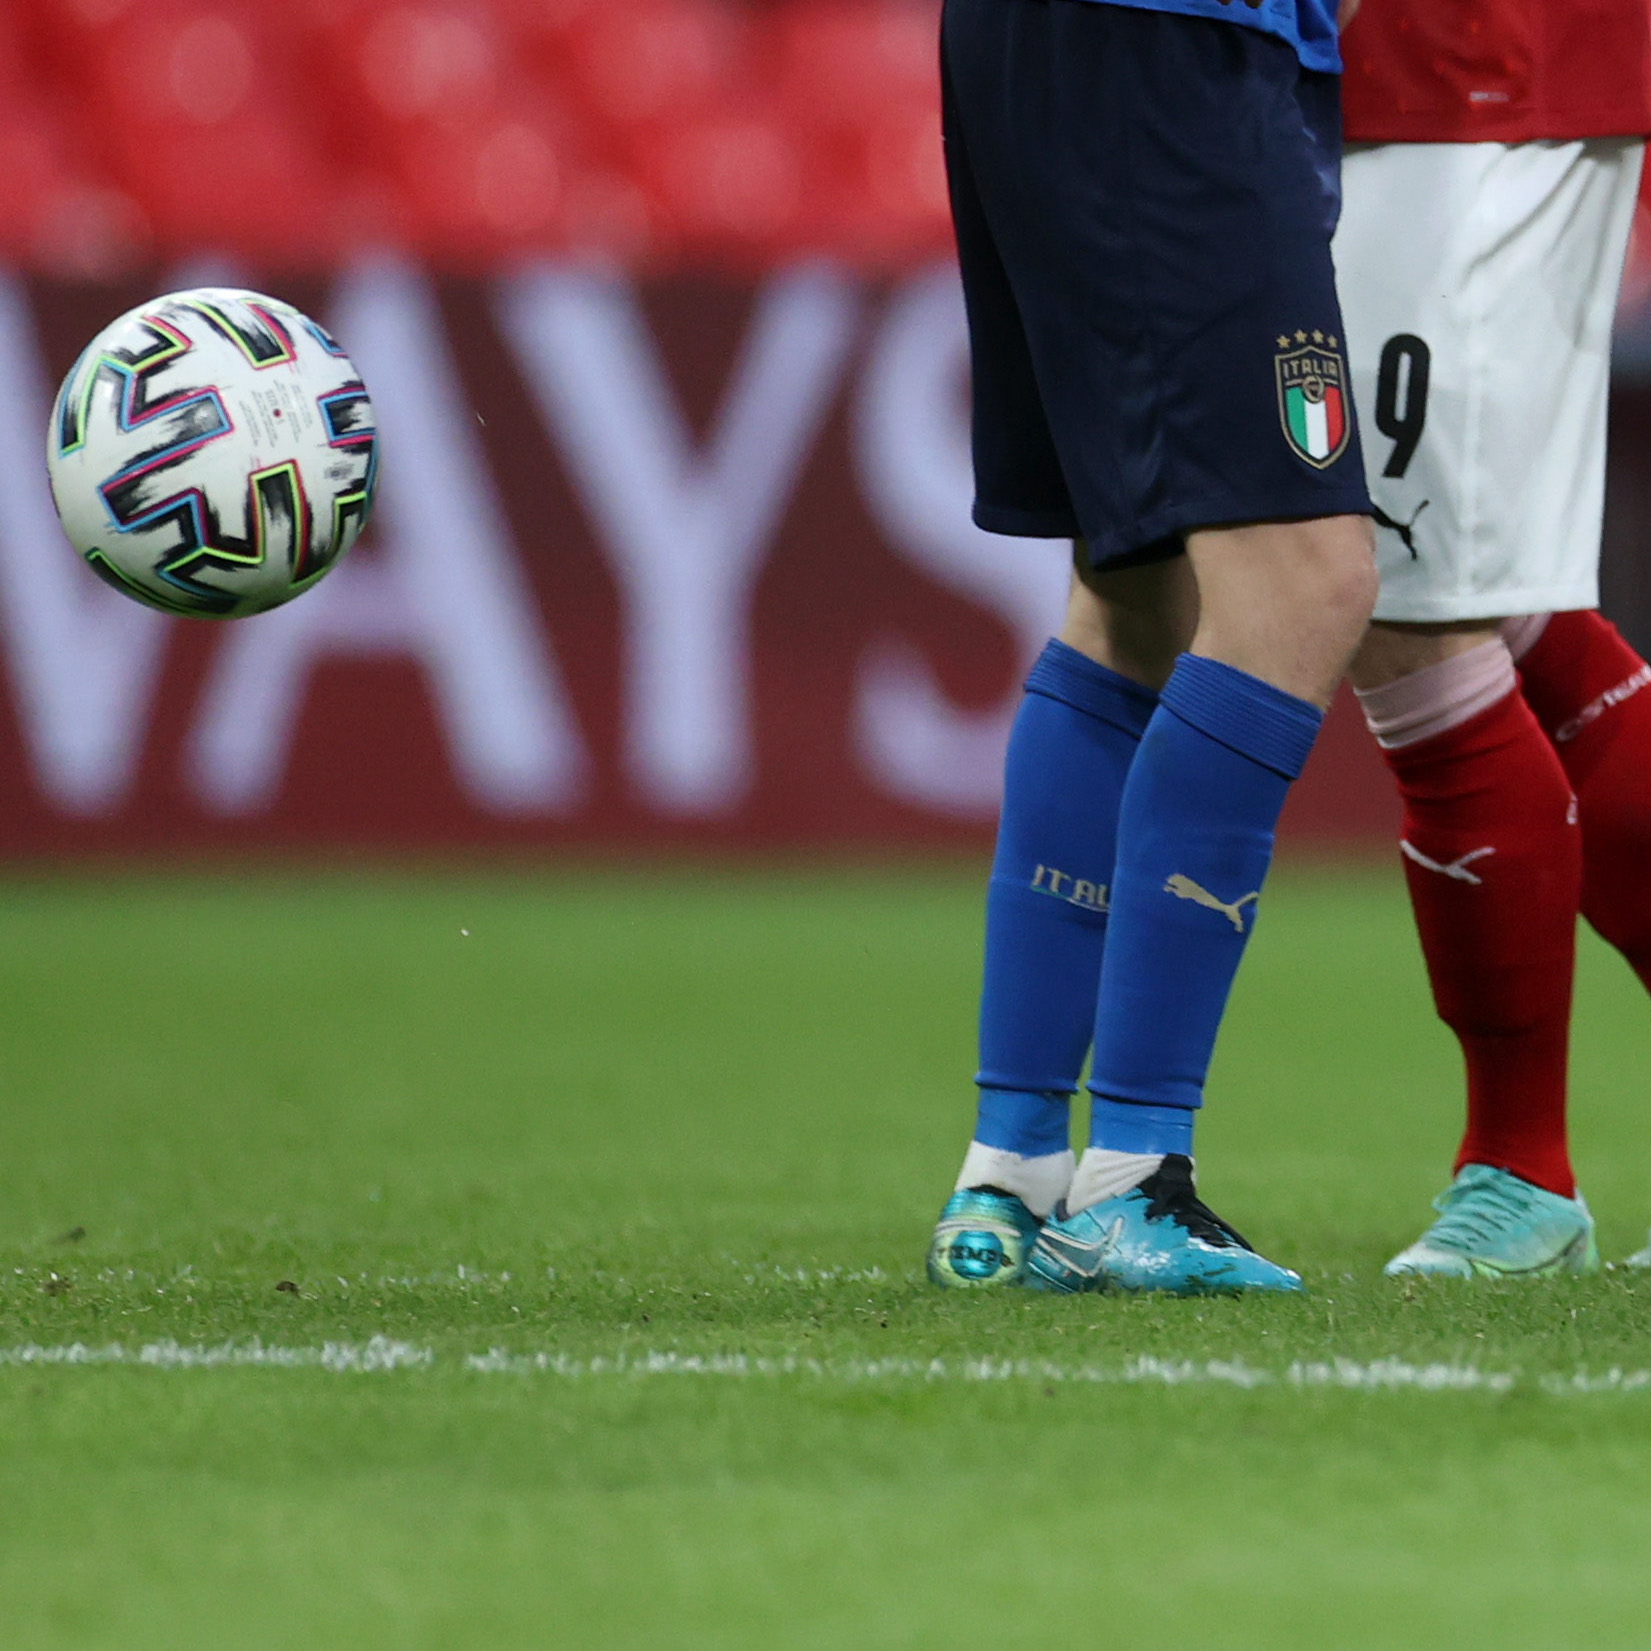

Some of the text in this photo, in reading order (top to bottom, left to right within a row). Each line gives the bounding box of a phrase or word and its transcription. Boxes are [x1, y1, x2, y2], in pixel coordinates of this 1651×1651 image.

[1283, 358, 1339, 379] ITALIA
[1375, 333, 1430, 479] 9
[1031, 863, 1109, 908] ITAL
